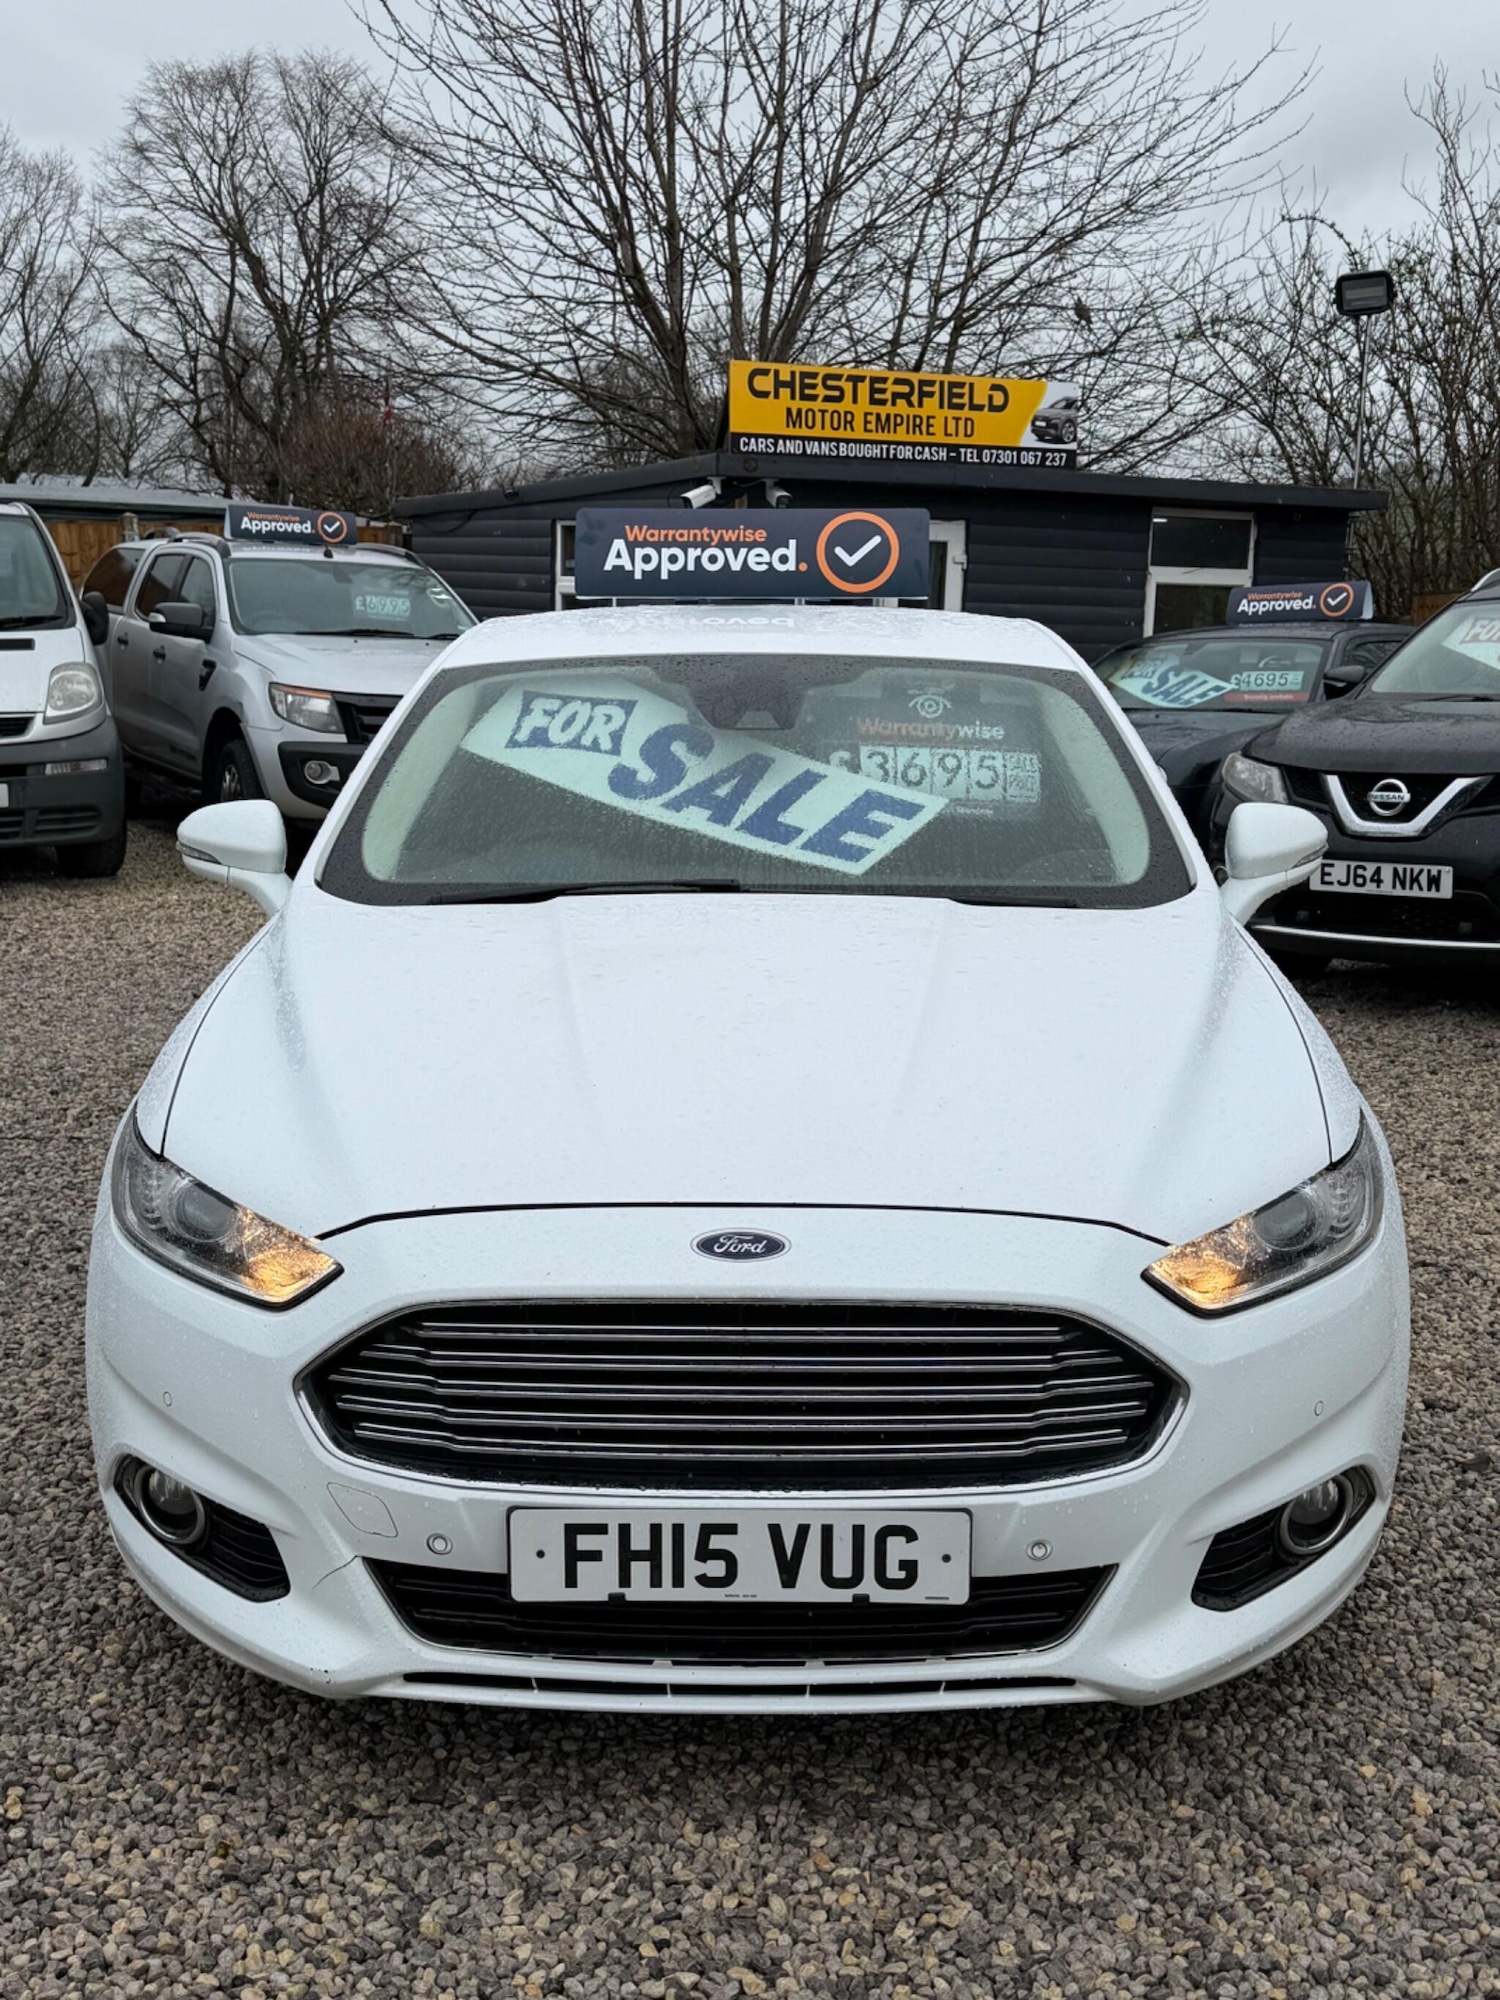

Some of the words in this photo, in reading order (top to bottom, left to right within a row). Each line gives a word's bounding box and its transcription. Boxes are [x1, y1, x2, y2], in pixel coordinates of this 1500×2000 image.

[747, 367, 1010, 413] CHESTERFIELD
[785, 407, 855, 433] MOTOR
[863, 411, 936, 437] EMPIRE
[943, 416, 975, 438] LTD
[739, 437, 775, 453] CARS
[776, 439, 803, 455] AND
[804, 440, 838, 456] VANS
[839, 442, 888, 459] BOUGHT
[889, 445, 914, 460] FOR
[914, 446, 947, 461] CASH
[959, 448, 980, 462] TEL
[982, 449, 1017, 465] 07301
[1020, 451, 1042, 465] 067
[1045, 452, 1067, 466] 237
[240, 516, 316, 534] Approved.
[624, 525, 767, 546] Warrantywise
[603, 538, 808, 580] Approved.
[355, 596, 410, 614] £6995
[1237, 595, 1317, 616] Approved.
[1247, 591, 1303, 600] Warrantywise
[1141, 664, 1228, 705] SALE
[1229, 672, 1289, 689] £4695
[857, 716, 1005, 741] Warrantywise
[515, 696, 628, 752] FOR
[608, 722, 926, 863] SALE
[1372, 793, 1405, 801] NISSAN
[1320, 863, 1384, 889] EJ64
[1392, 866, 1442, 893] NKW
[713, 1234, 768, 1254] Ford
[563, 1522, 738, 1589] FH15
[767, 1523, 920, 1590] VUG
